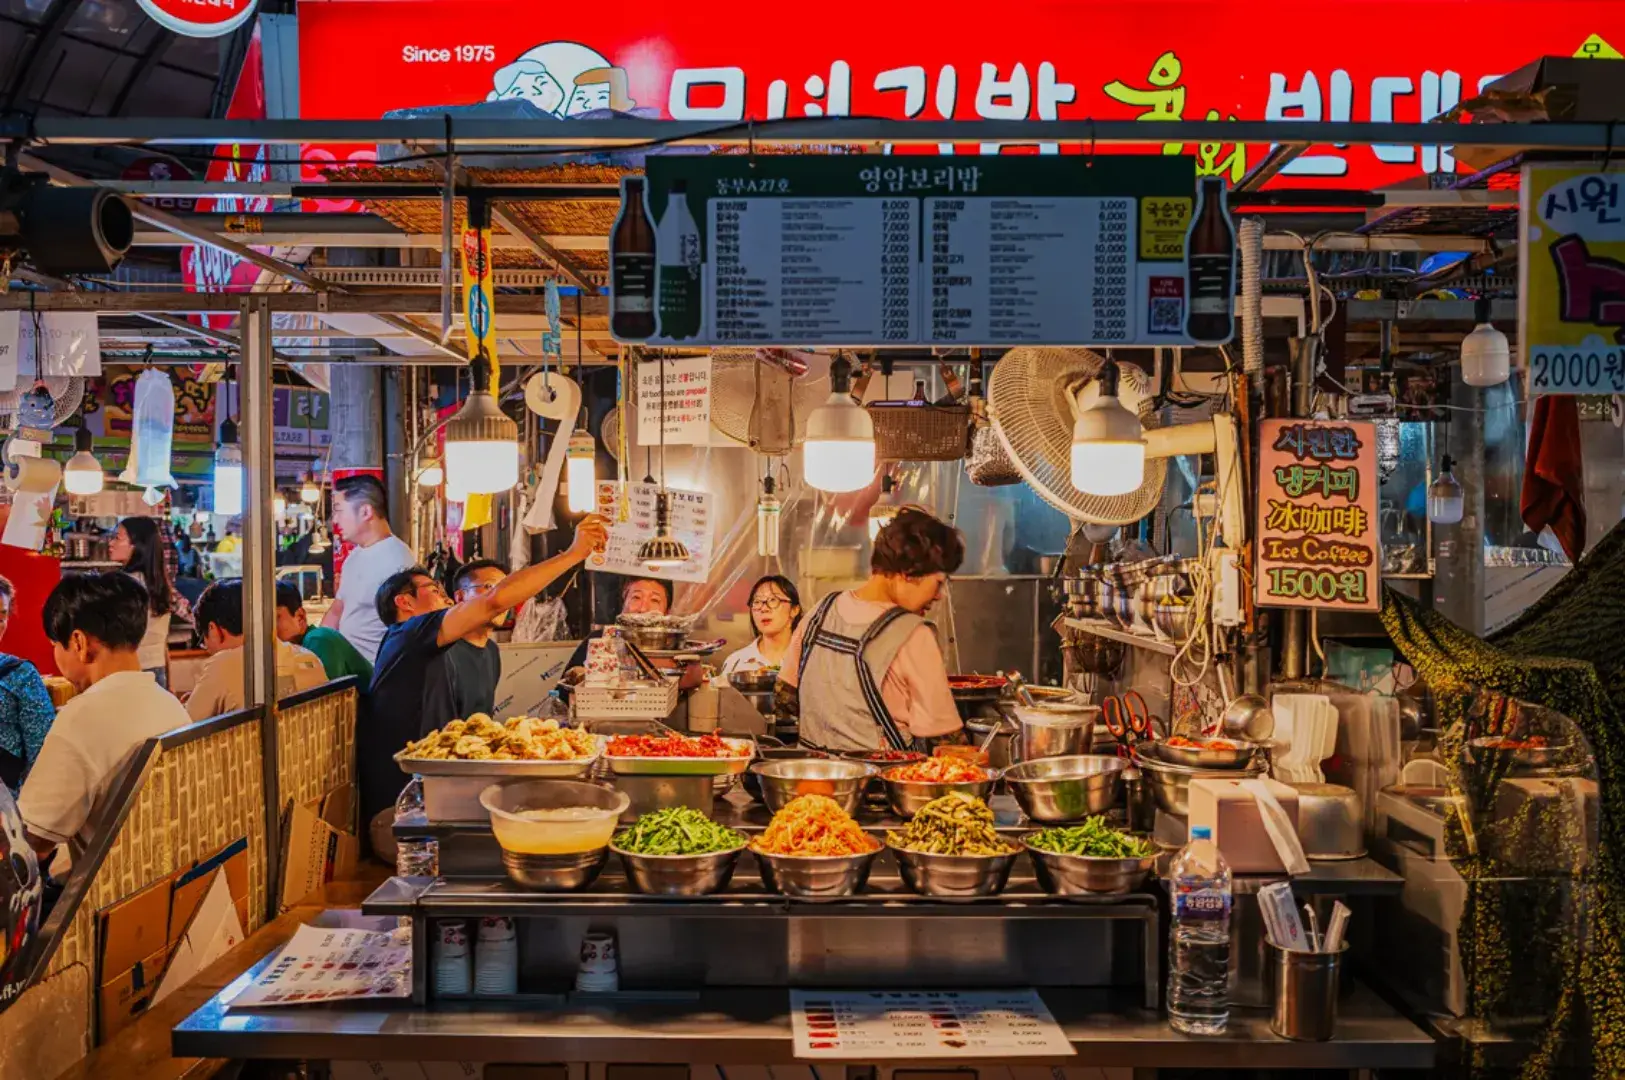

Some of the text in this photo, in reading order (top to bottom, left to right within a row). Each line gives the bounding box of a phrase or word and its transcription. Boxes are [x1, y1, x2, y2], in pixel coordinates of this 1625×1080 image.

[402, 45, 495, 62] Since 1975
[860, 166, 984, 192] 영암보리밥
[1546, 176, 1622, 224] 시원
[1147, 202, 1187, 218] 국순당
[881, 212, 909, 221] 7,000
[881, 223, 909, 232] 7,000
[881, 234, 909, 243] 7,000
[881, 244, 909, 253] 7,000
[1153, 245, 1182, 254] 5,000
[881, 277, 909, 286] 7,000
[881, 288, 909, 297] 7,000
[881, 298, 909, 307] 7,000
[881, 309, 909, 318] 7,000
[881, 320, 909, 329] 7,000
[881, 331, 909, 340] 7,000
[1534, 348, 1625, 391] 2000원
[1276, 424, 1362, 459] 시원한
[1275, 464, 1359, 499] 냉커피
[1267, 500, 1369, 537] 冰咖啡
[1269, 538, 1368, 562] Ice Coffee
[1268, 568, 1367, 602] 1500원
